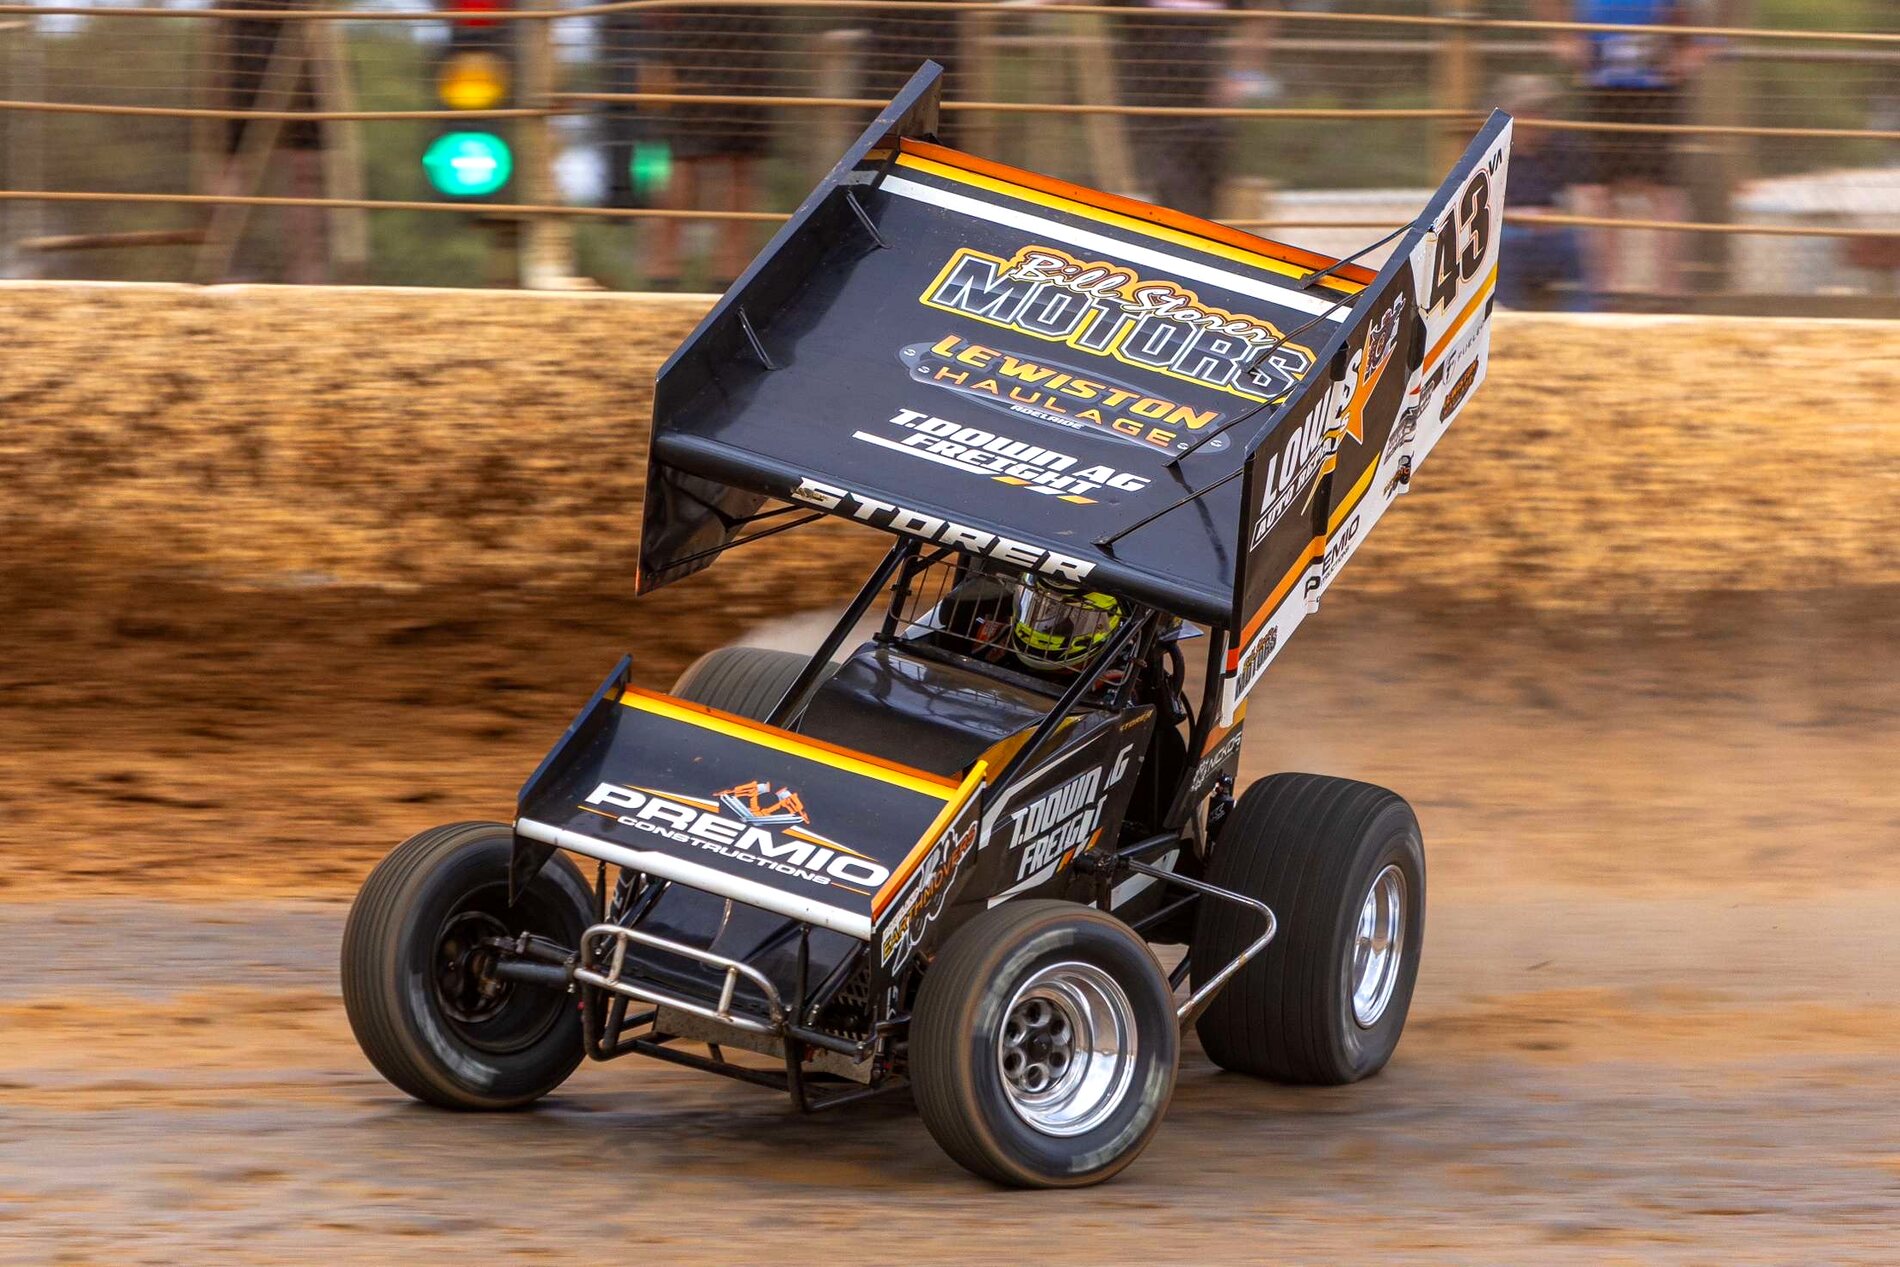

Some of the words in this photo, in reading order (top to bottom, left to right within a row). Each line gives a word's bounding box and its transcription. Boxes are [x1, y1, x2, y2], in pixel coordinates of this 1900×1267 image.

[1426, 168, 1491, 318] 43
[932, 256, 1308, 398] MOTORS
[1013, 254, 1121, 299] Bill
[1123, 287, 1277, 344] Storer
[930, 334, 1222, 431] LEWISTON
[933, 366, 1177, 447] HAULAGE
[1010, 405, 1084, 430] ADELAIDE
[889, 408, 1078, 471] T.DOWN
[1076, 464, 1151, 491] AG
[900, 432, 1102, 494] FREIGHT
[791, 477, 1097, 583] STORER
[1256, 484, 1295, 543] AUTO
[1304, 514, 1360, 600] PEMIO
[584, 782, 890, 887] PREMIO
[617, 815, 832, 885] CONSTRUCTIONS
[883, 826, 977, 960] EARTHMOVERS
